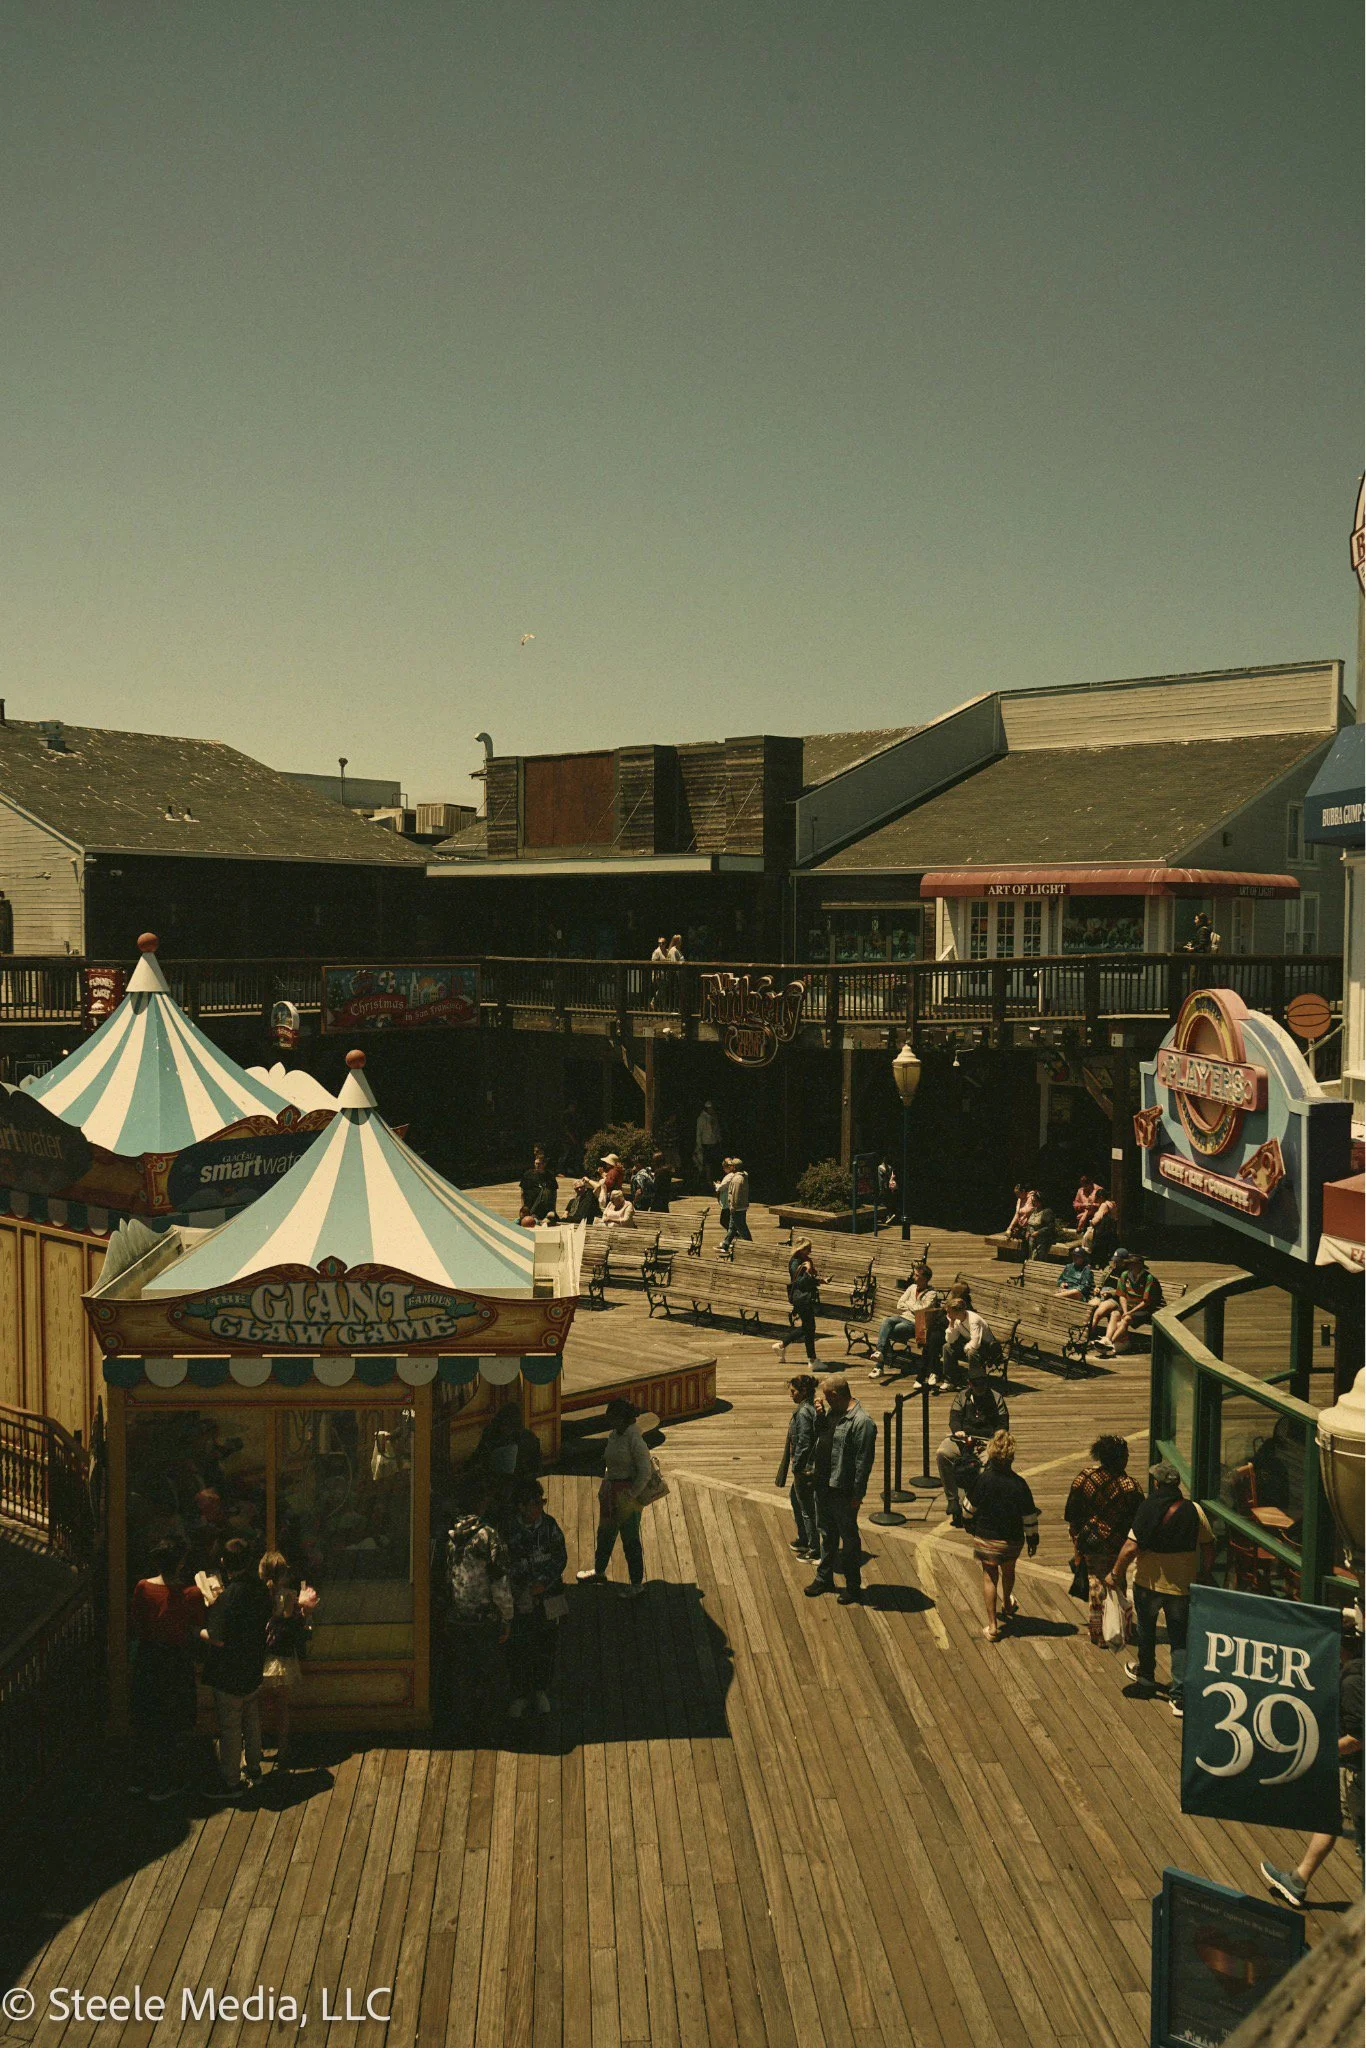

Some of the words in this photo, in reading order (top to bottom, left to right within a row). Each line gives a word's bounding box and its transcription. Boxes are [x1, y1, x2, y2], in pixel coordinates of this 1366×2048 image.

[1322, 807, 1343, 827] BUBBA
[1343, 803, 1363, 824] GUMP
[988, 885, 1011, 896] ART
[1013, 885, 1028, 896] OF
[1030, 884, 1067, 895] LIGHT
[350, 1000, 404, 1016] Christmas
[405, 1013, 413, 1021] in
[415, 1010, 429, 1018] San
[429, 1003, 464, 1014] Francisco
[1166, 1055, 1246, 1104] PLAYERS
[209, 1294, 248, 1306] THE
[251, 1280, 415, 1323] GIANT
[408, 1294, 452, 1307] FAMOUS
[210, 1315, 331, 1346] CLAW
[337, 1314, 458, 1346] GAME
[1203, 1630, 1316, 1692] PIER
[1195, 1681, 1320, 1786] 39
